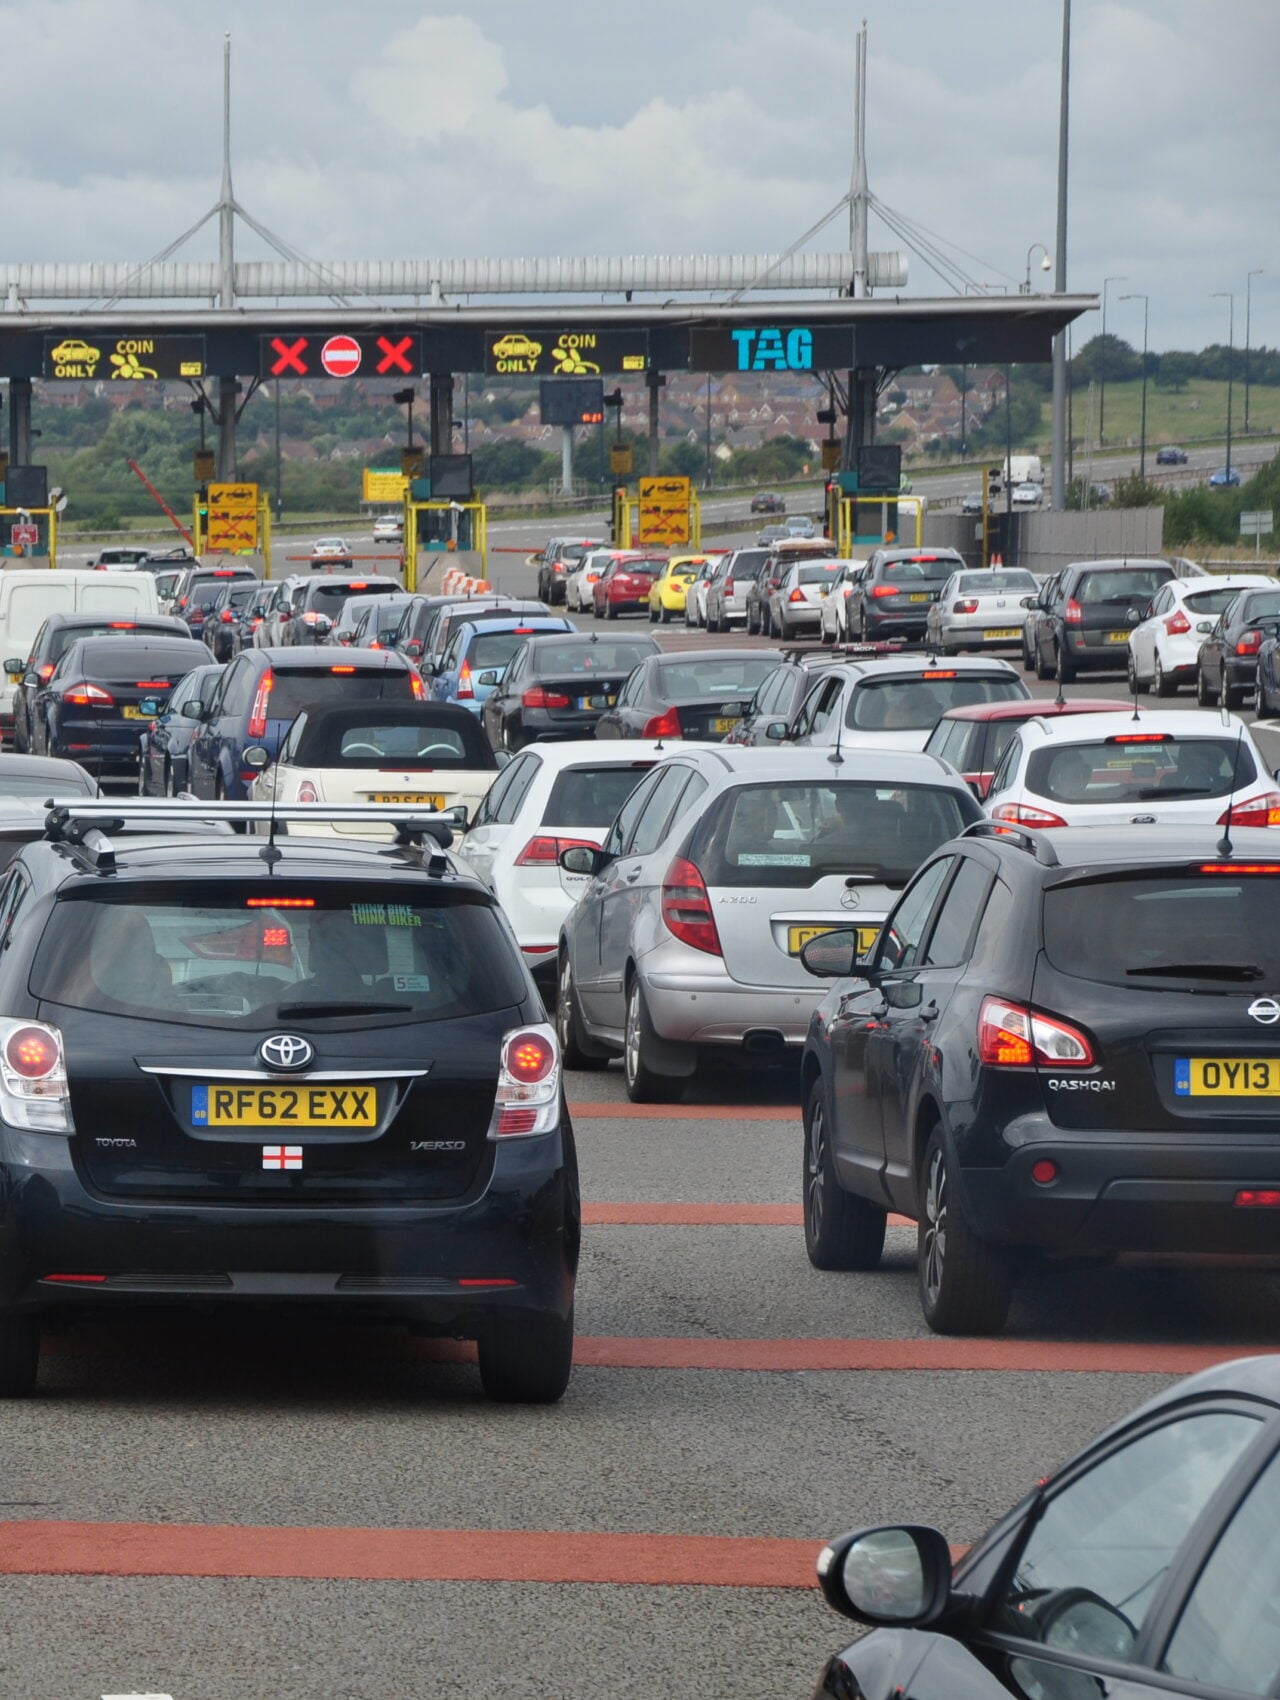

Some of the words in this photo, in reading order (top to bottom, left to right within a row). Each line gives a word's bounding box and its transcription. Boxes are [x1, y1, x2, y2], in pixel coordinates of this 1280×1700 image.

[116, 340, 154, 354] COIN
[558, 334, 596, 348] COIN
[732, 329, 812, 370] TAG
[54, 364, 96, 378] ONLY
[496, 360, 538, 373] ONLY
[351, 903, 385, 915] THINK
[387, 904, 414, 916] BIKE
[352, 913, 387, 925] THINK
[388, 915, 422, 927] BIKER
[397, 977, 407, 990] 5
[1202, 1062, 1270, 1089] OY13
[1048, 1079, 1116, 1092] QASHQAI
[215, 1090, 298, 1119] RF62
[309, 1091, 369, 1119] EXX
[194, 1110, 206, 1119] GB
[95, 1137, 137, 1148] TOYOTA
[410, 1140, 466, 1150] VERSO
